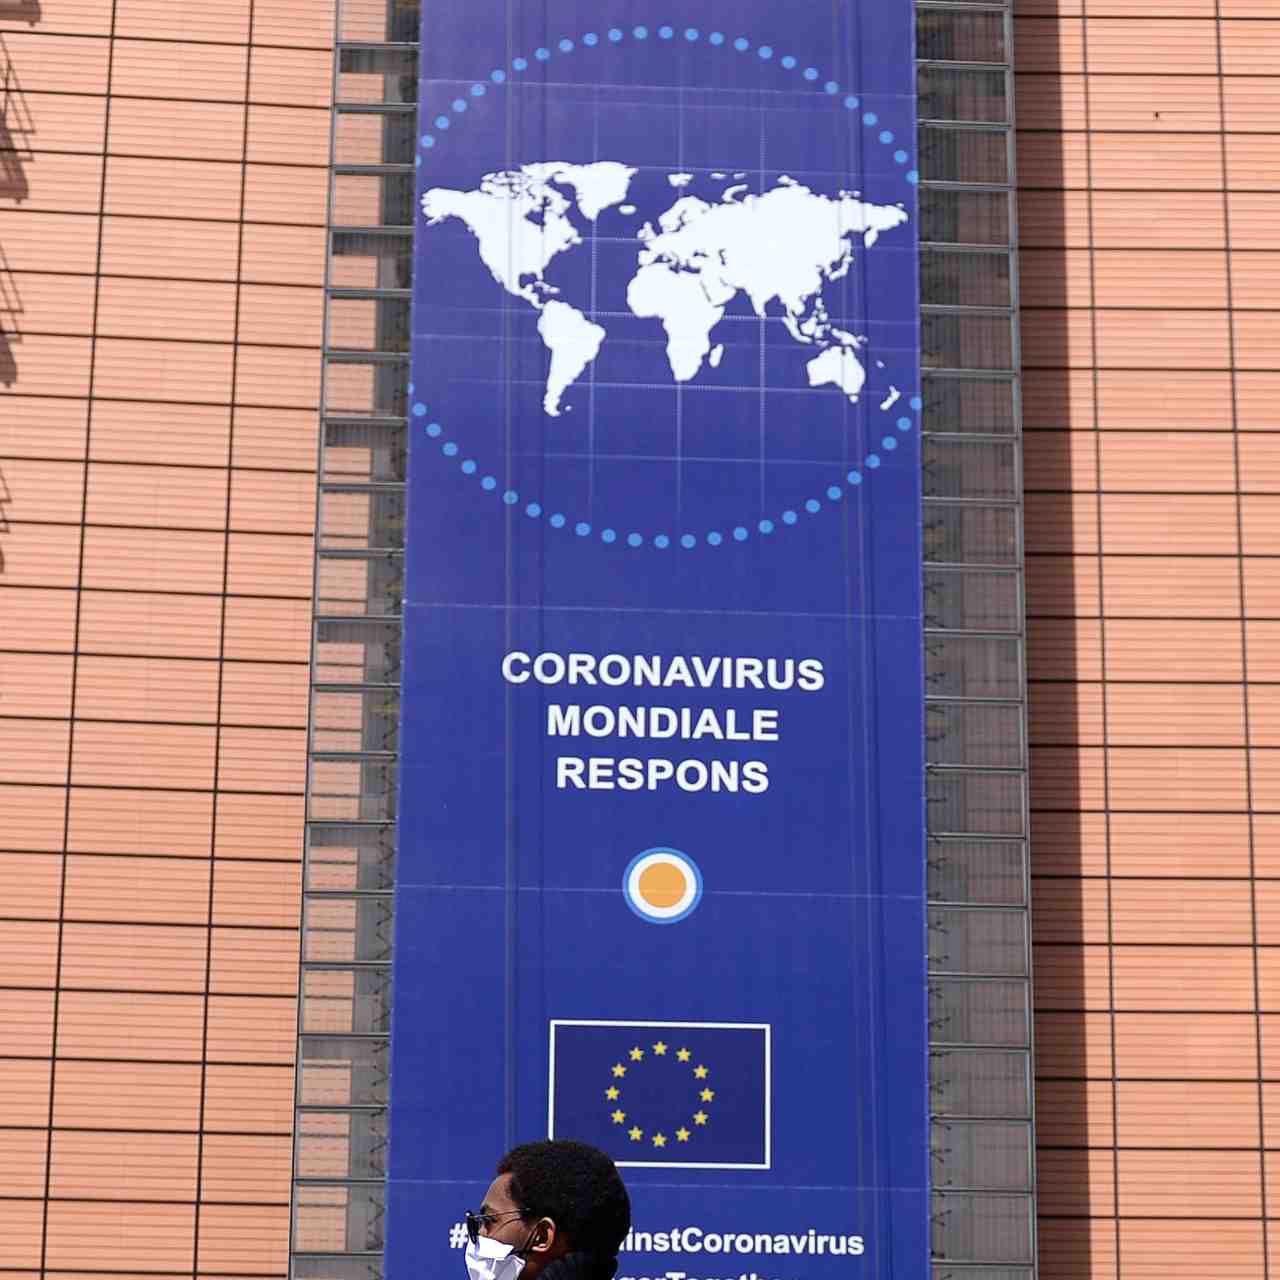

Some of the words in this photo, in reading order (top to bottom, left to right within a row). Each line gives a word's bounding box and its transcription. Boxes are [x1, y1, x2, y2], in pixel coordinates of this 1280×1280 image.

[502, 651, 824, 691] CORONAVIRUS
[547, 704, 779, 741] MONDIALE
[556, 757, 769, 793] RESPONS
